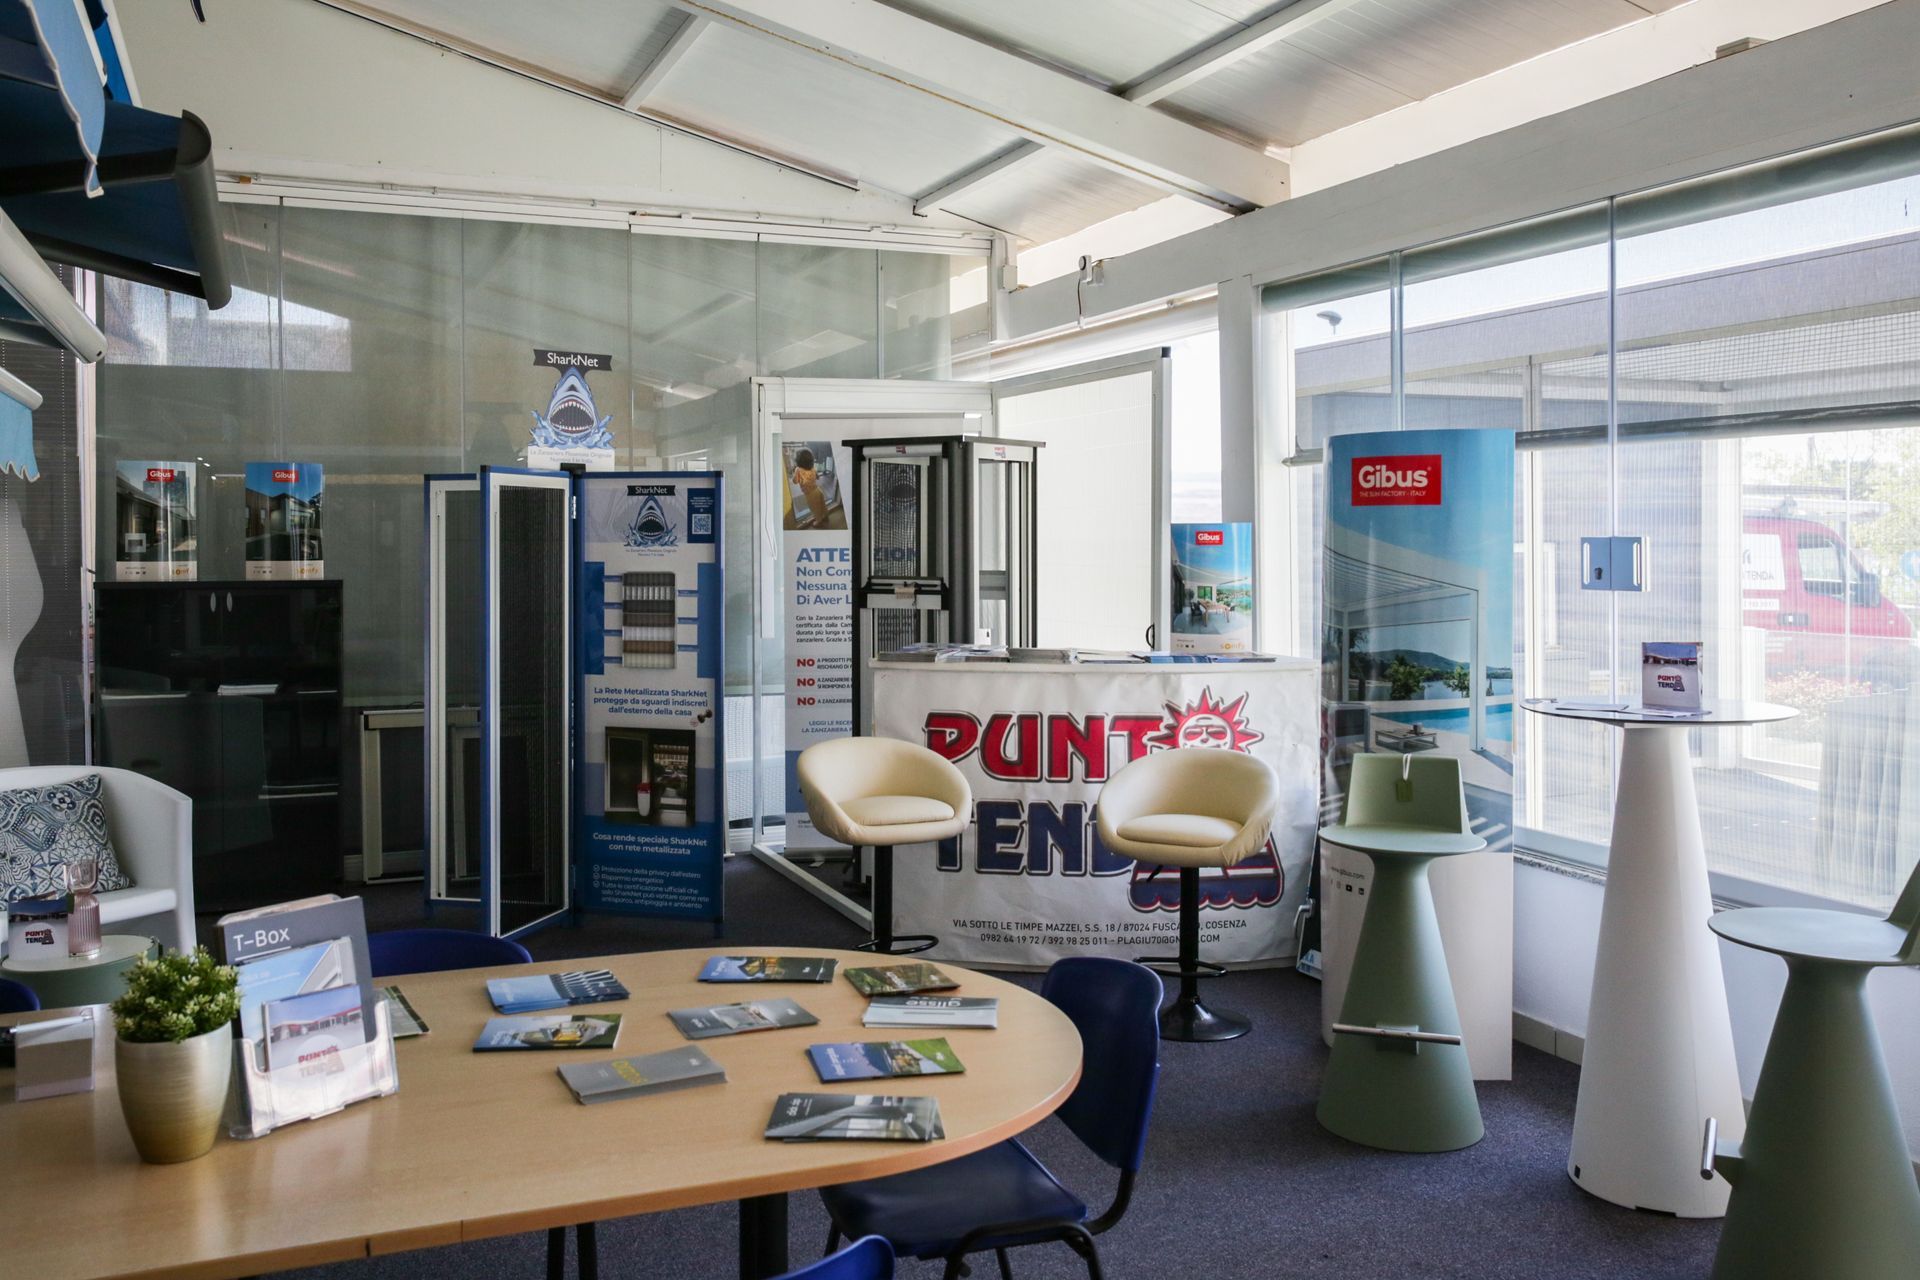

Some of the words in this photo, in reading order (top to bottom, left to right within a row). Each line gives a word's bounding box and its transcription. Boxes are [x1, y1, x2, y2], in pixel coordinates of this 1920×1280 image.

[547, 352, 598, 367] SharkNet
[150, 470, 172, 478] Gibus
[274, 471, 296, 479] Gibus
[1358, 464, 1429, 489] Gibus
[635, 486, 667, 495] SharkNet
[1198, 533, 1220, 542] Gibus
[797, 566, 822, 577] Non
[826, 566, 853, 577] Con
[797, 580, 847, 591] Nessuna
[797, 595, 810, 605] Di
[814, 595, 842, 605] Aver
[796, 658, 815, 667] NO
[797, 678, 815, 686] NO
[605, 687, 622, 695] Rete
[624, 688, 669, 696] Metallizzata
[670, 689, 707, 698] SharkNet
[593, 697, 629, 706] protegge
[641, 698, 671, 707] sguardi
[672, 699, 708, 707] indiscreti
[797, 697, 816, 705] NO
[608, 706, 653, 715] dall'esterno
[593, 832, 612, 841] Cosa
[613, 834, 636, 842] rende
[637, 835, 669, 844] speciale
[670, 837, 708, 847] SharkNet
[625, 844, 641, 852] rete
[642, 846, 691, 855] metallizzata
[648, 869, 670, 878] privacy
[631, 876, 664, 885] energetico
[614, 889, 641, 897] SharkNet
[953, 919, 968, 928] VIA
[969, 920, 998, 930] SOTTO
[1001, 921, 1012, 930] LE
[1015, 921, 1043, 931] TIMPE
[1046, 923, 1083, 933] MAZZEI,
[1085, 923, 1102, 932] S.S.
[1105, 923, 1116, 932] 18
[1124, 922, 1150, 932] 87024
[1205, 919, 1247, 930] COSENZA
[232, 928, 291, 952] T-Box
[980, 933, 1001, 943] 0982
[1003, 934, 1014, 944] 64
[1017, 934, 1028, 944] 19
[1029, 935, 1041, 945] 72
[1048, 935, 1064, 945] 392
[1066, 935, 1078, 945] 98
[1079, 935, 1091, 945] 25
[1092, 935, 1108, 945] 011
